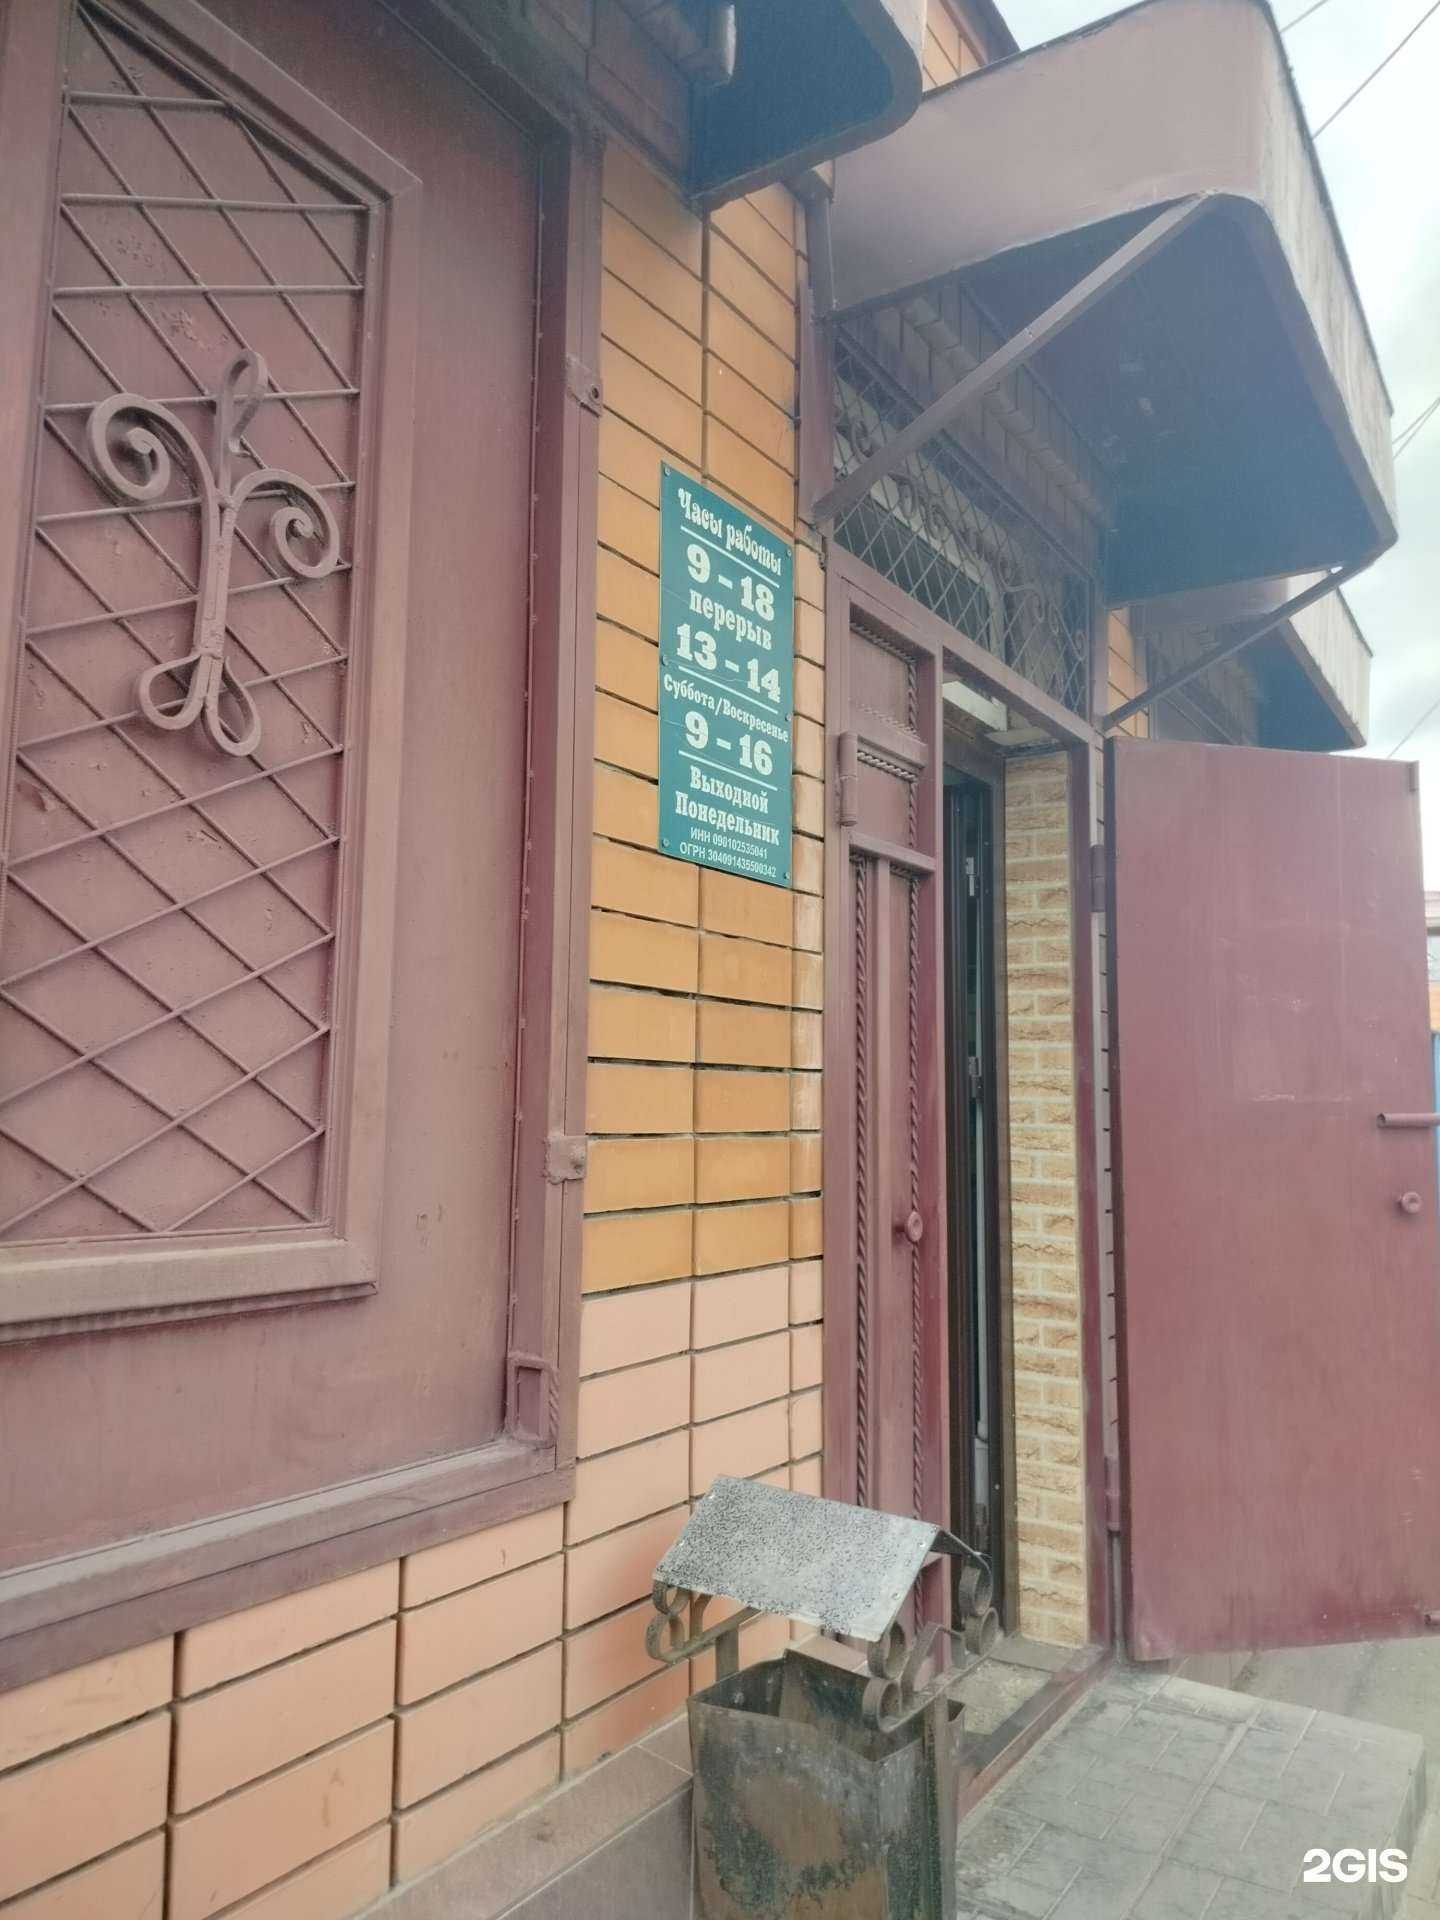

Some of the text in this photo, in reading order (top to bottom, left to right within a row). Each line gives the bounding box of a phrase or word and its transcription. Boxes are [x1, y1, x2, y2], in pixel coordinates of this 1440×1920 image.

[678, 488, 781, 576] Часы работы
[687, 544, 710, 583] 9
[741, 576, 774, 620] 18
[689, 589, 772, 650] перерыв
[677, 623, 717, 670] 13
[747, 658, 780, 703] 14
[663, 673, 788, 742] Суббота/Воскресенье
[685, 711, 708, 748] 9
[740, 734, 773, 776] 16
[675, 791, 779, 845] Понедельник
[690, 765, 768, 813] Выходной
[680, 842, 705, 859] ОГРН
[690, 827, 711, 844] ИНН
